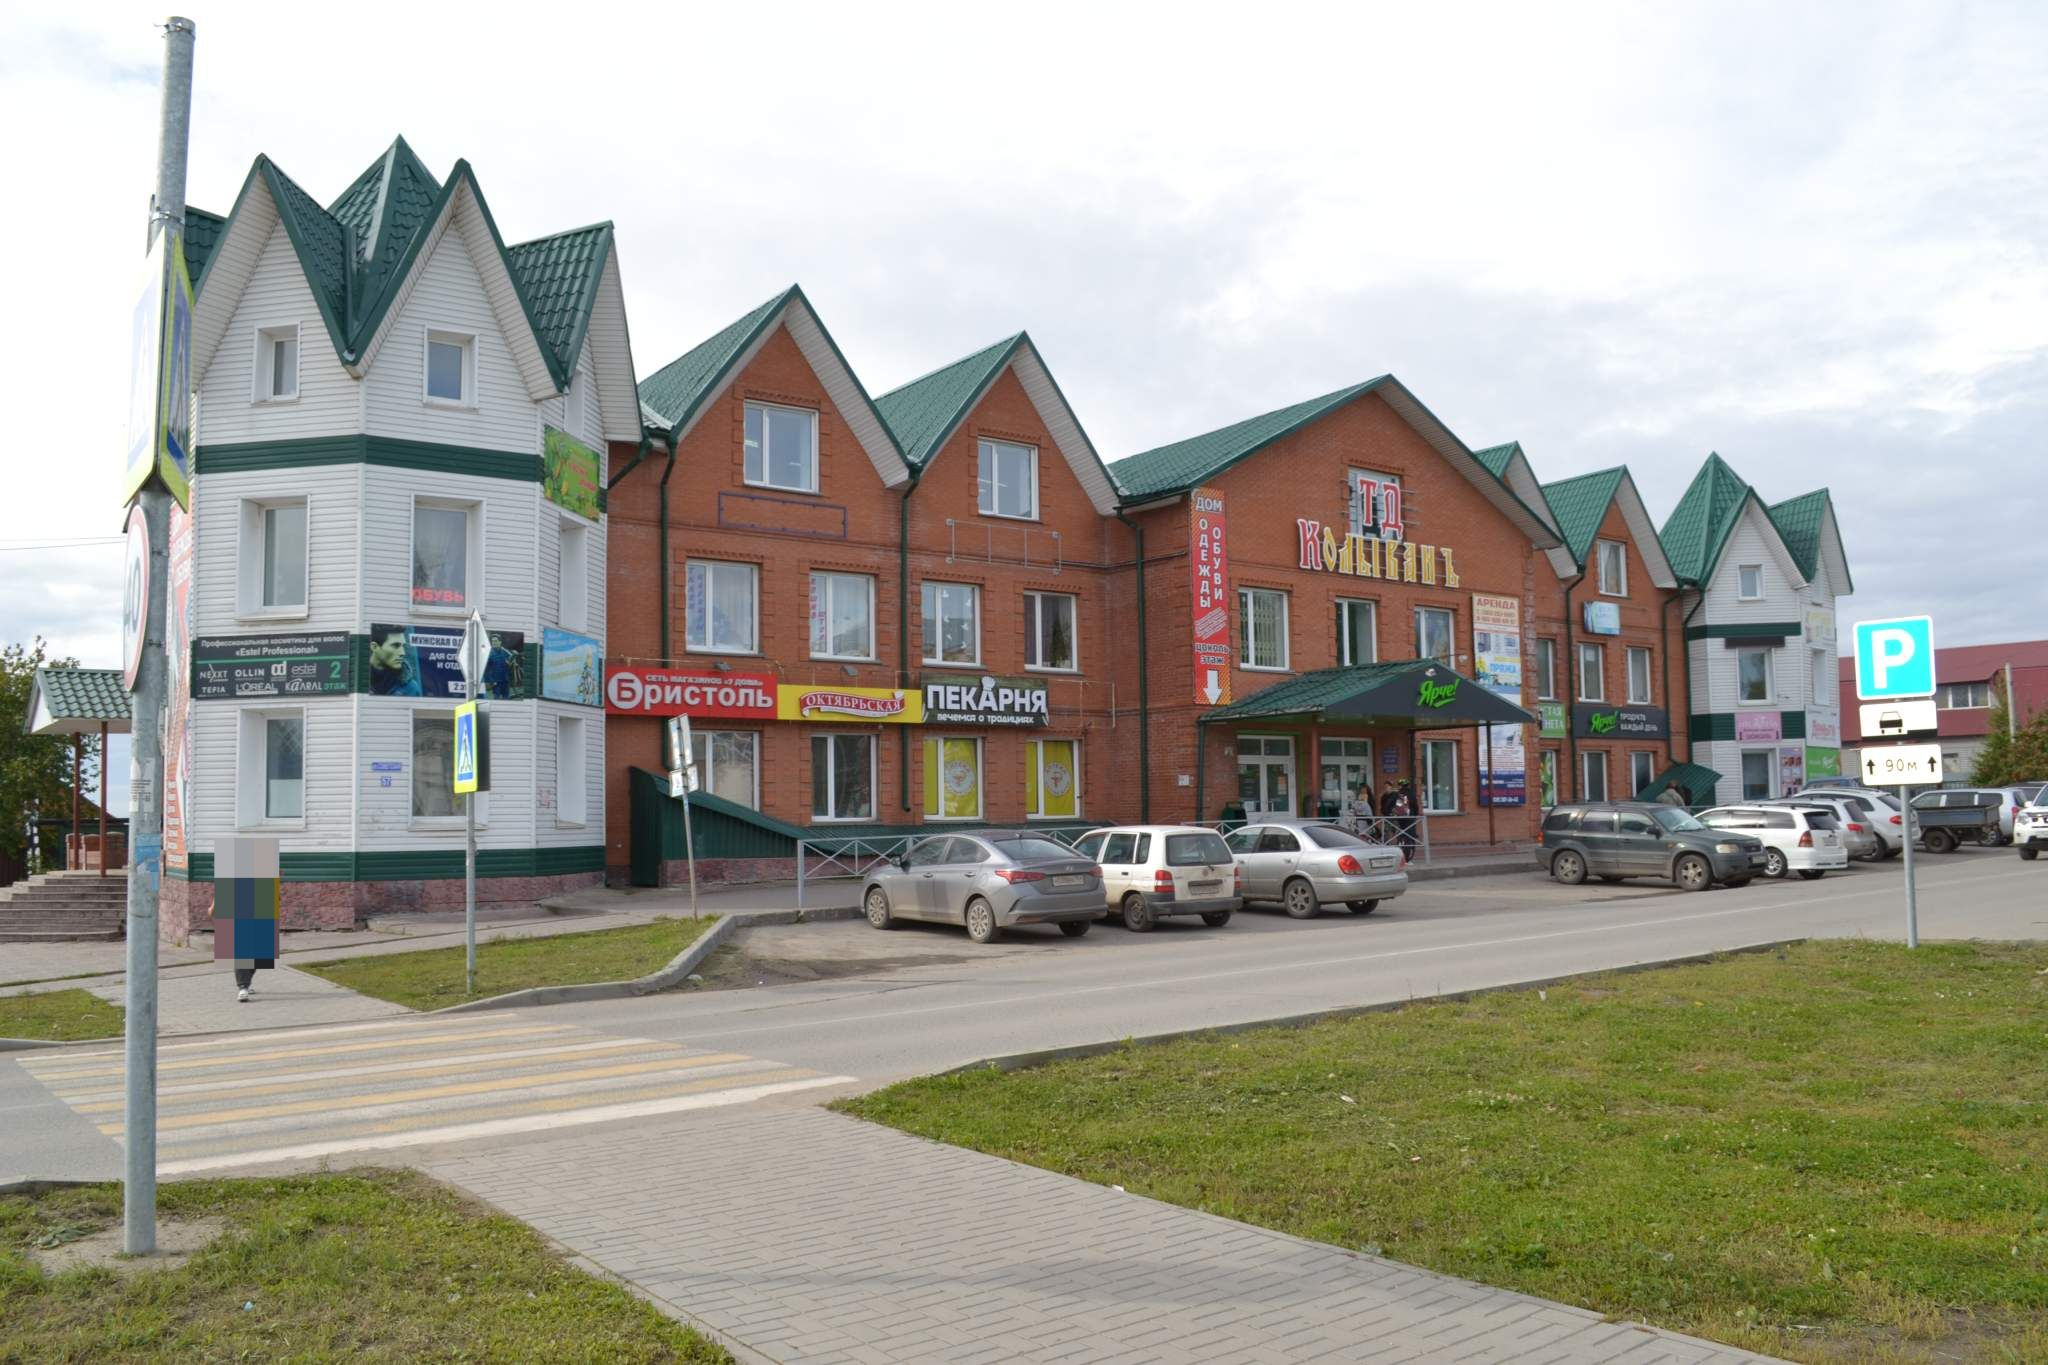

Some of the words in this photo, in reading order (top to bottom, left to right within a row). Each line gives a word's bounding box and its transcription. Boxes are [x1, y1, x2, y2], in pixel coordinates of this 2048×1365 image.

[1196, 497, 1223, 513] ДОМ
[1358, 475, 1404, 540] ТД
[1198, 518, 1211, 608] ОДЕЖДЫ
[1212, 527, 1223, 600] ОБУВИ
[307, 636, 322, 644] для
[323, 635, 345, 643] волос
[411, 635, 451, 647] МУЖСКАЯ
[428, 652, 445, 661] ДЛЯ
[1872, 628, 1915, 689] P
[200, 665, 228, 680] NEXXT
[235, 668, 265, 677] OLLIN
[291, 662, 317, 676] estel
[330, 661, 341, 678] 2
[437, 661, 444, 670] И
[202, 686, 226, 694] TEFIA
[607, 672, 774, 710] Бристоль
[927, 684, 1047, 713] ПЕКАРНЯ
[1417, 678, 1461, 706] Ярче!
[805, 694, 901, 712] ОКТЯБРЬСКАЯ
[1589, 710, 1619, 733] Ярче!
